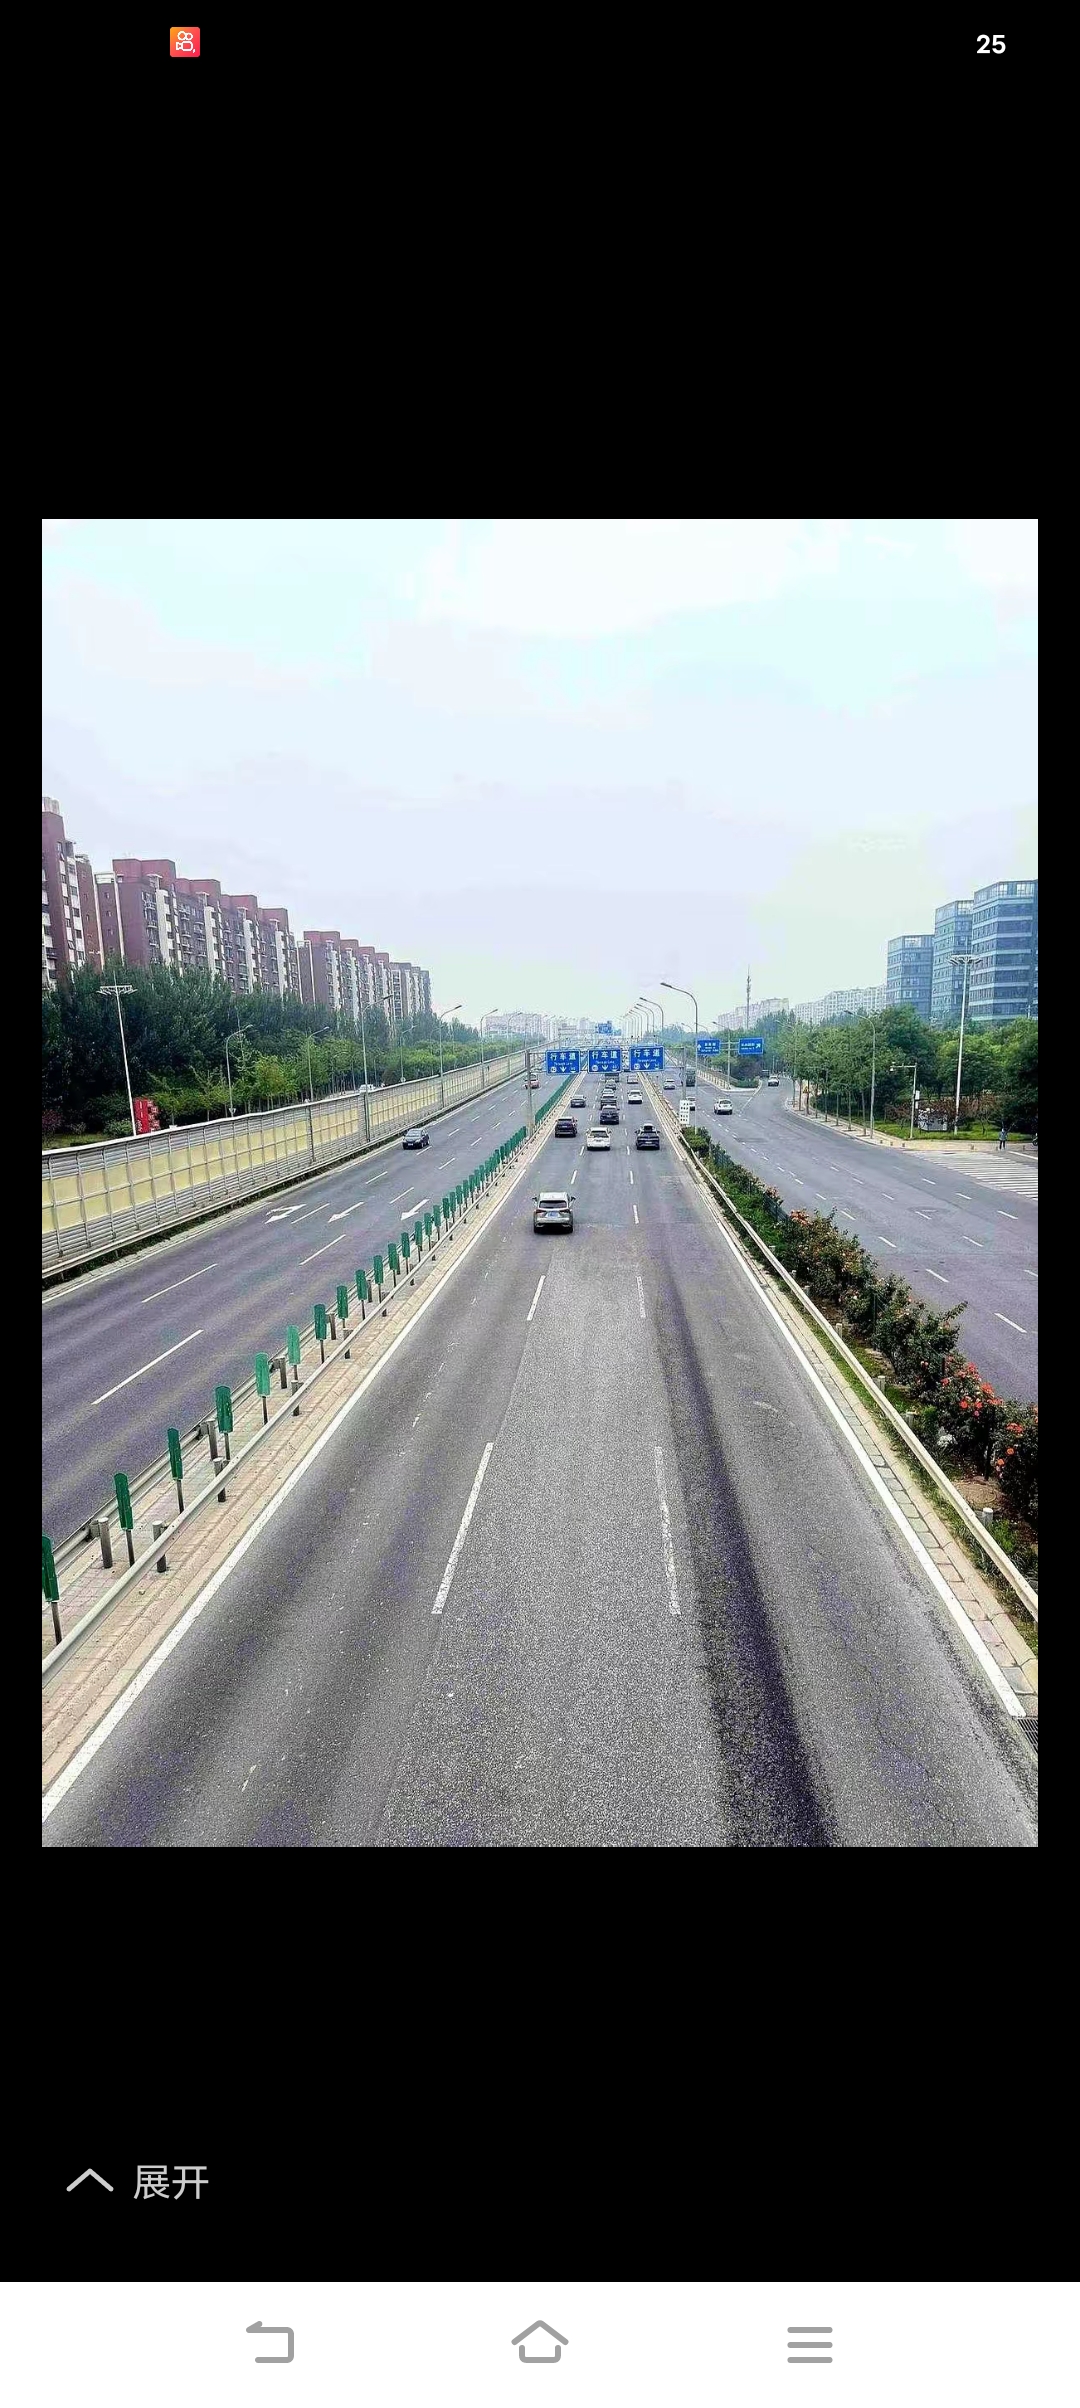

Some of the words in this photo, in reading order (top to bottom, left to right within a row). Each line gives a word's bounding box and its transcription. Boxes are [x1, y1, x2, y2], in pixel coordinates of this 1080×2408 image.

[550, 1052, 576, 1061] 行车道
[591, 1050, 618, 1059] 行车道
[633, 1048, 660, 1057] 行车道
